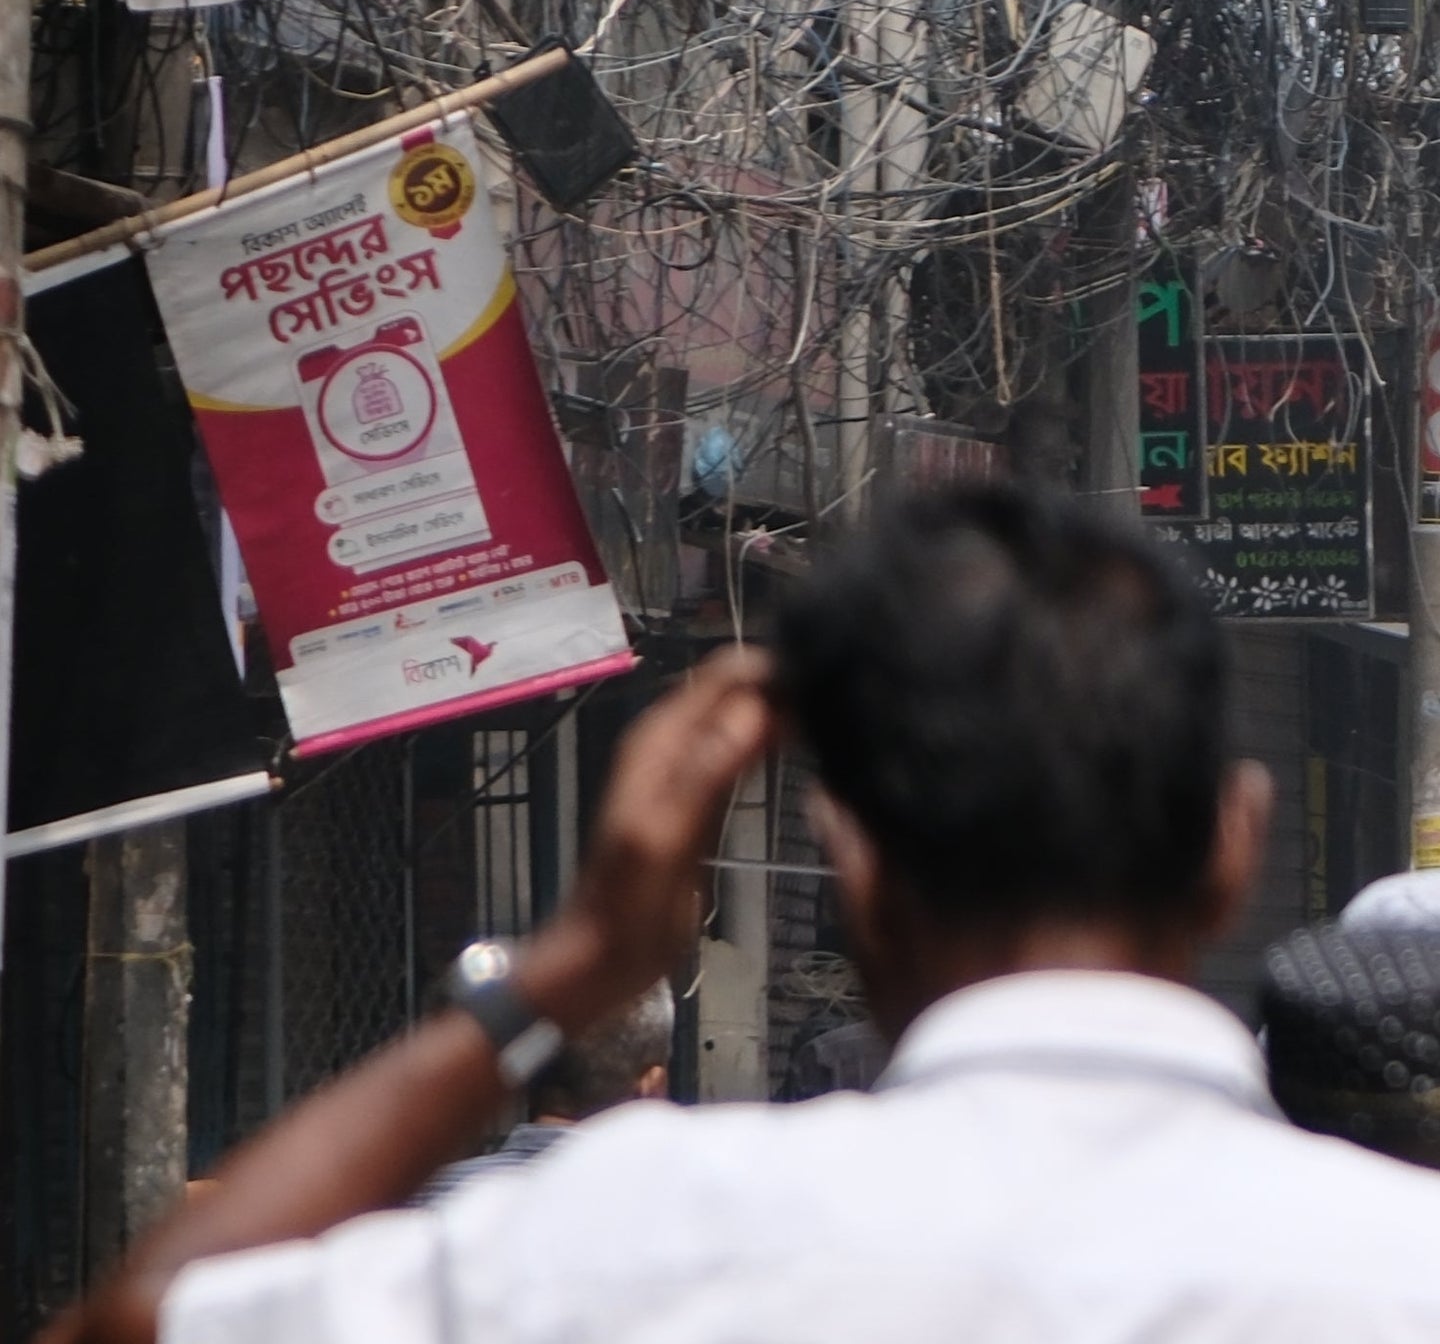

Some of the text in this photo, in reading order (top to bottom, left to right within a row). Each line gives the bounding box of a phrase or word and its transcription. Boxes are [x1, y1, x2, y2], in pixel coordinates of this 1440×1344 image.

[221, 214, 392, 302] পছন্দের
[268, 248, 442, 344] সেভিংস
[402, 655, 462, 685] বিকাশ
